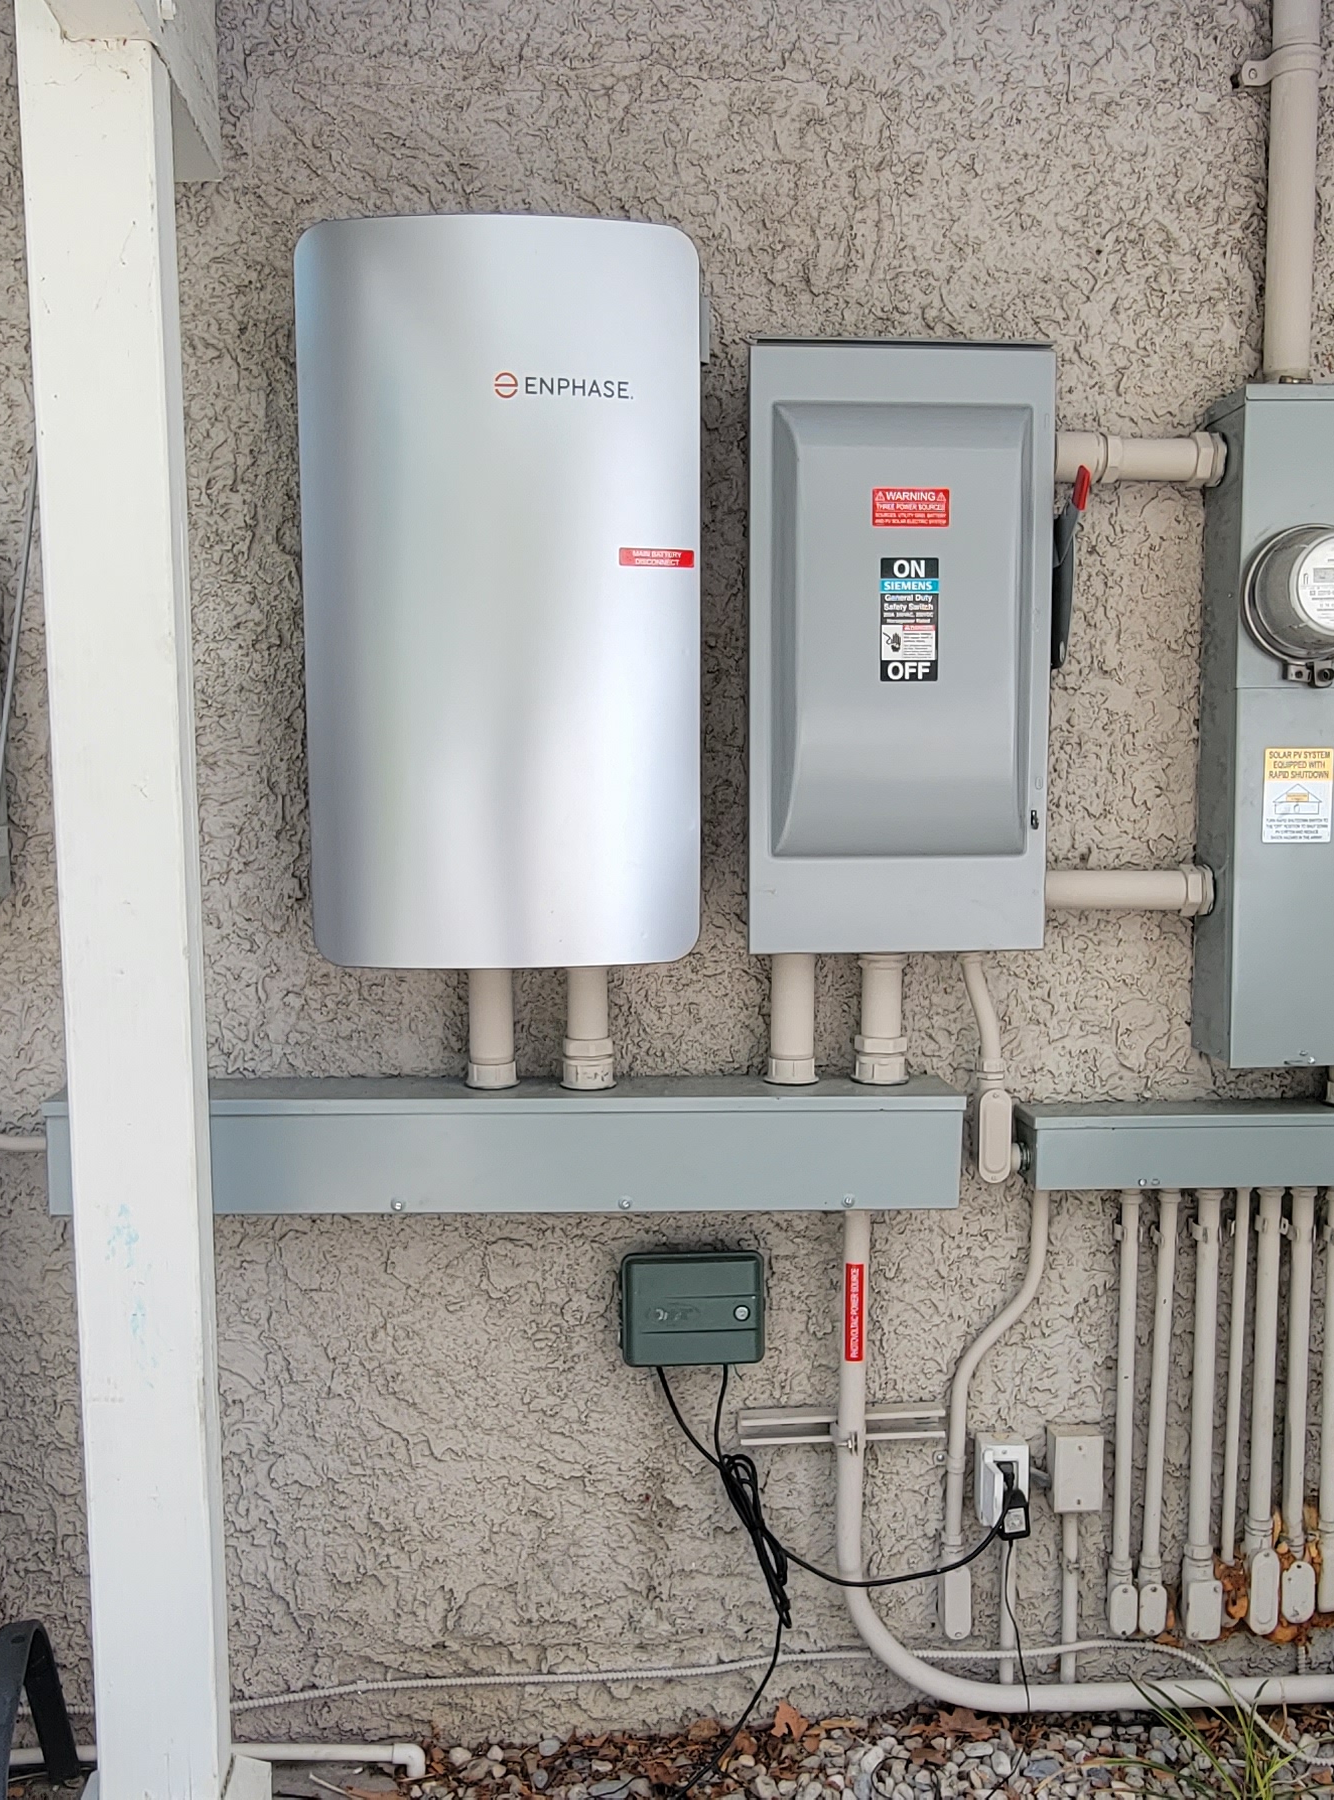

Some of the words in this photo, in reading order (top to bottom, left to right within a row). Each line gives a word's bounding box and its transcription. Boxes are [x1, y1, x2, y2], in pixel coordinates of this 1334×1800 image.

[885, 491, 936, 501] WARNING
[635, 558, 680, 566] DISCONNECT
[893, 559, 926, 578] ON
[883, 581, 933, 591] SIEMENS
[884, 594, 914, 602] General
[915, 594, 933, 603] Duty
[883, 603, 907, 612] Safety
[908, 603, 934, 611] Switch
[887, 661, 931, 680] OFF
[1269, 751, 1292, 759] SOLAR
[1293, 751, 1302, 759] PV
[1303, 751, 1331, 759] SYSTEM
[1273, 760, 1307, 769] EQUIPPED
[1308, 760, 1326, 769] WITH
[1268, 770, 1289, 779] RAPID
[1290, 770, 1329, 779] SHUTDOWN
[850, 1267, 859, 1293] SOURCE
[850, 1293, 859, 1315] POWER
[850, 1316, 859, 1358] PHOTOVOLTAIC
